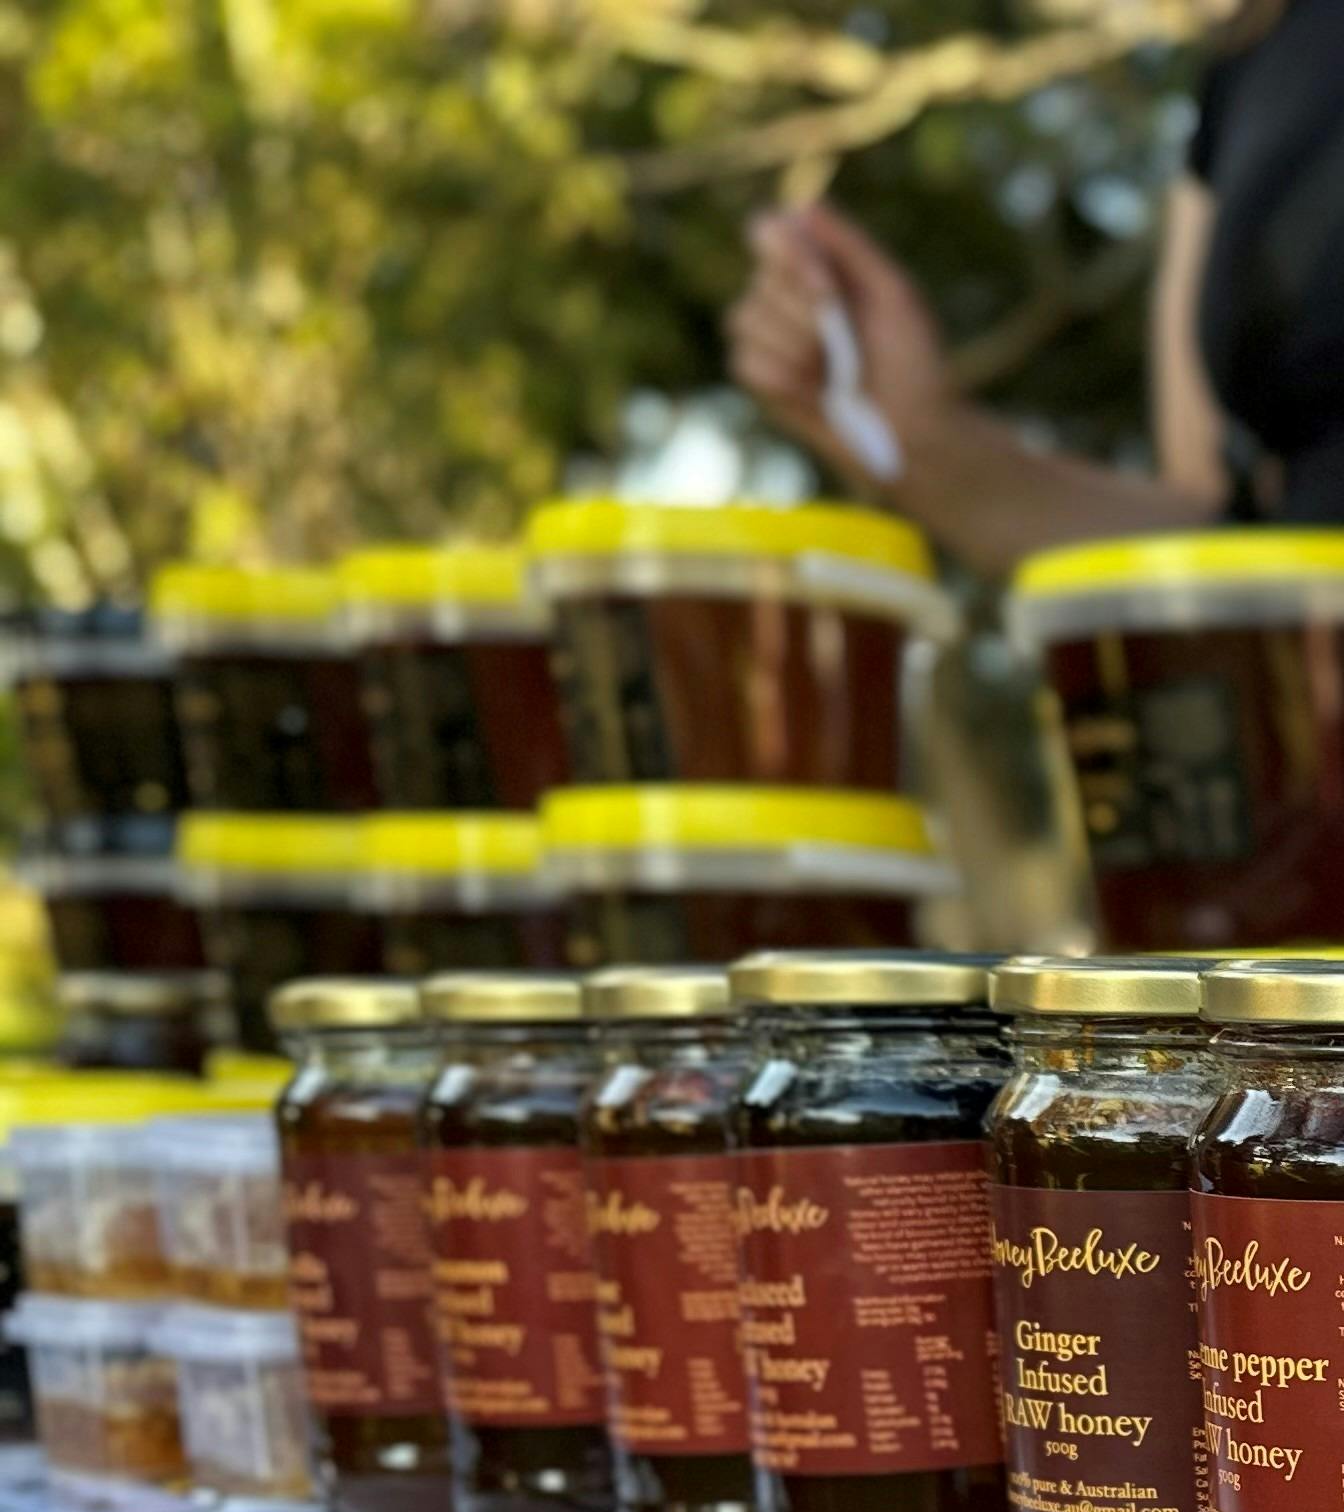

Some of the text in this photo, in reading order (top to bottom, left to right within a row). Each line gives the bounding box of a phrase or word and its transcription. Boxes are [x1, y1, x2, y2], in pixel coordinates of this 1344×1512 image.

[1016, 1321, 1101, 1361] Ginger
[1017, 1359, 1109, 1396] Infused
[1233, 1351, 1329, 1388] pepper
[1004, 1393, 1152, 1446] RAW honey
[1046, 1441, 1078, 1460] 500g
[1228, 1429, 1303, 1481] honey
[1032, 1479, 1057, 1496] pure
[1060, 1480, 1071, 1495] &
[1075, 1481, 1157, 1499] Australian
[1219, 1467, 1241, 1491] 500g
